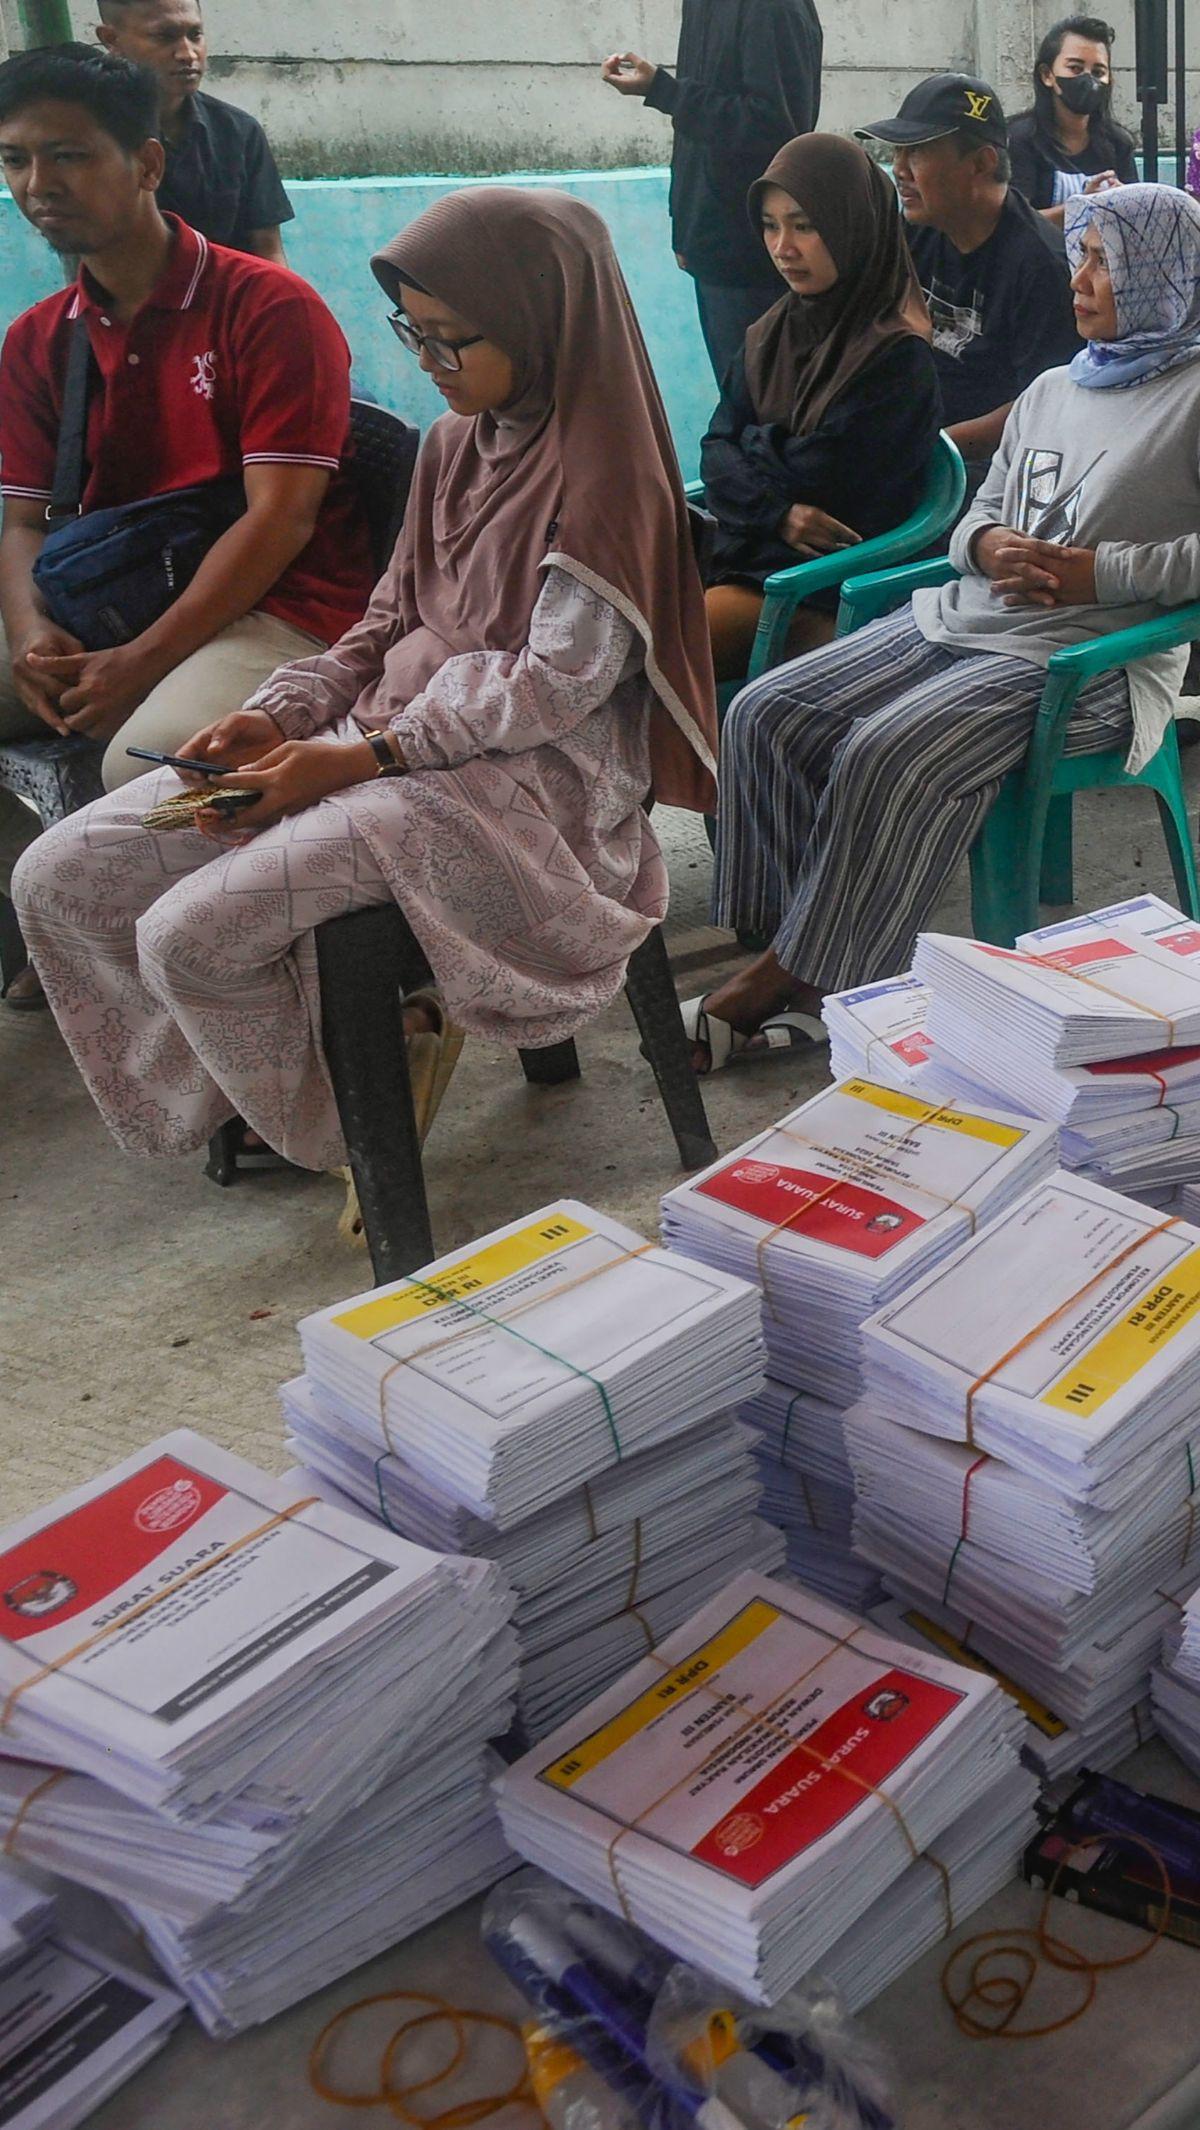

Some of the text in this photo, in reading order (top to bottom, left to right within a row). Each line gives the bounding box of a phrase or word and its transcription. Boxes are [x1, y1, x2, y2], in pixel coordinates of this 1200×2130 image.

[773, 1178, 866, 1220] SURAT SUARA
[537, 1224, 571, 1240] III
[460, 1278, 484, 1290] RI
[1125, 1285, 1174, 1326] DPR RI
[1151, 1292, 1186, 1322] BANTEN
[1063, 1381, 1096, 1405] III
[88, 1584, 159, 1628] SURAT
[155, 1539, 228, 1584] SUARA
[655, 1659, 710, 1699] DPR RI
[786, 1687, 824, 1718] DEWAN
[697, 1734, 753, 1776] INDONESIA
[726, 1717, 790, 1766] PEWAKILAN
[816, 1727, 871, 1772] SURAT
[557, 1759, 582, 1776] III
[686, 1765, 729, 1796] RAKYAT
[761, 1770, 823, 1816] SUARA
